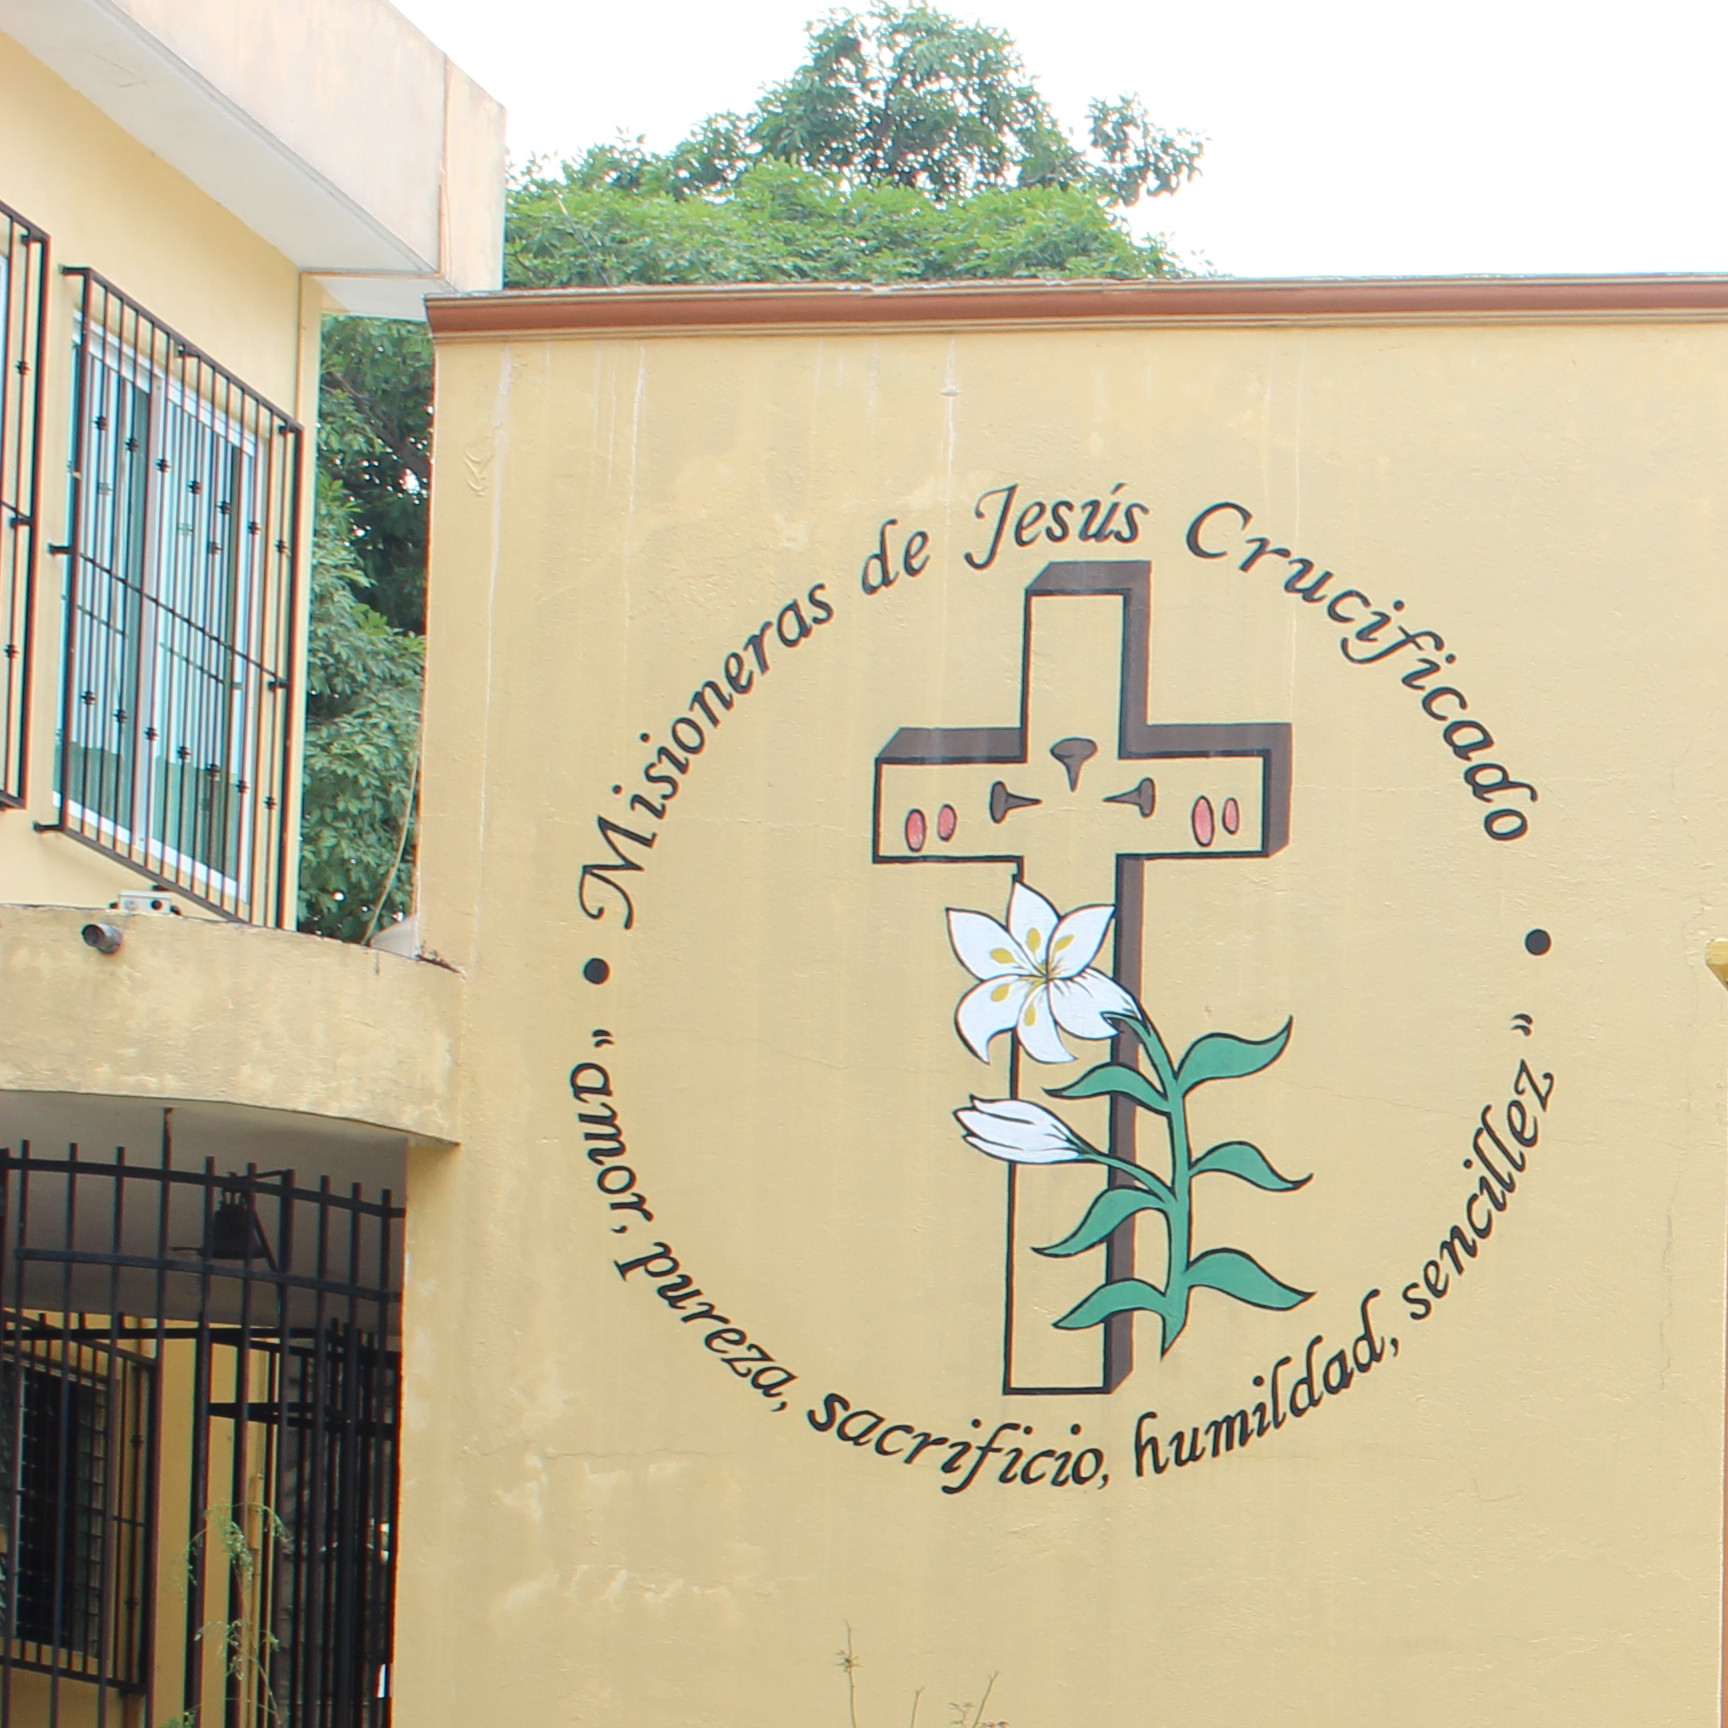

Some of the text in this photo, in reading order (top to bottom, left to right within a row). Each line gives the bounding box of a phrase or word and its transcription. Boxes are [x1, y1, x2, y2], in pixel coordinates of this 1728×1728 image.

[578, 482, 1539, 931] Misioneras de Jesús Crucificado
[612, 1240, 798, 1413] pureza,
[805, 1391, 1110, 1496] sacrificio,
[1133, 1287, 1400, 1478] humildad,
